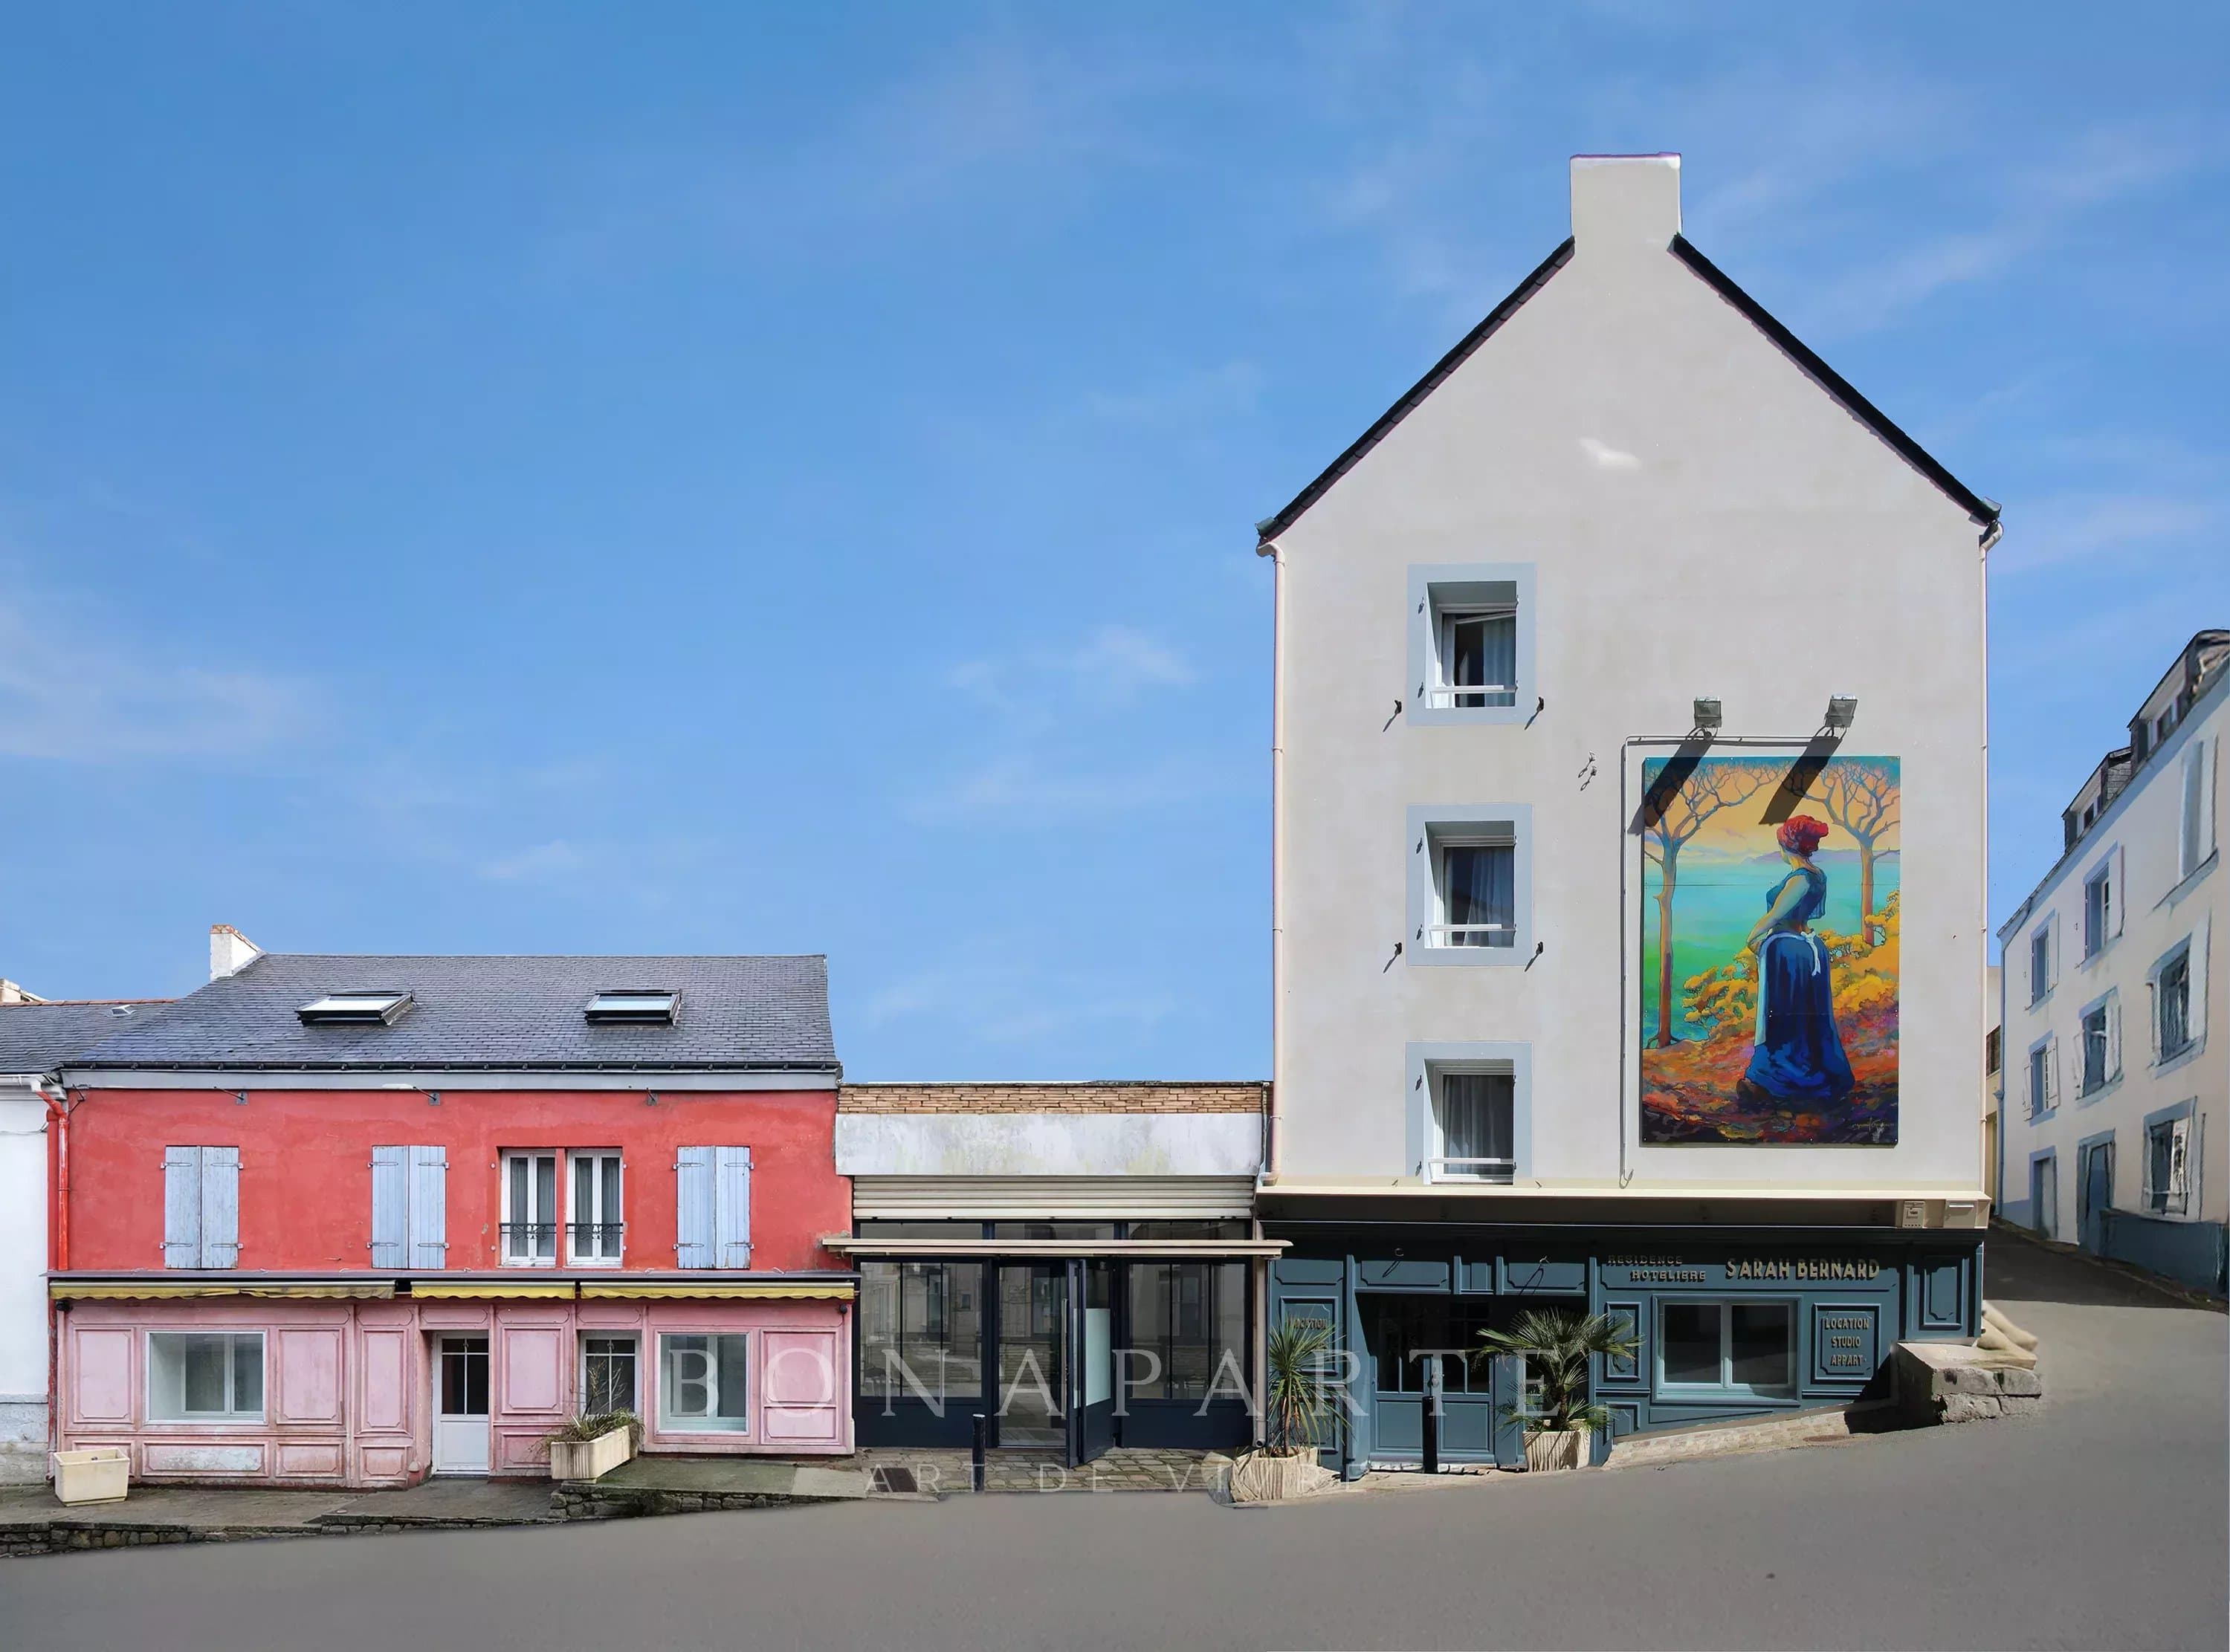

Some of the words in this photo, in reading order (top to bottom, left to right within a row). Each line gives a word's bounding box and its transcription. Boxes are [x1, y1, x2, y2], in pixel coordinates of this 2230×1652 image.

[1607, 1255, 1683, 1265] RESIDENCE
[1726, 1259, 1790, 1278] SARAH
[1797, 1257, 1880, 1278] BERNARD
[1631, 1270, 1707, 1280] HOTELIERE
[1825, 1318, 1869, 1329] LOCATION
[1831, 1336, 1861, 1347] STUDIO
